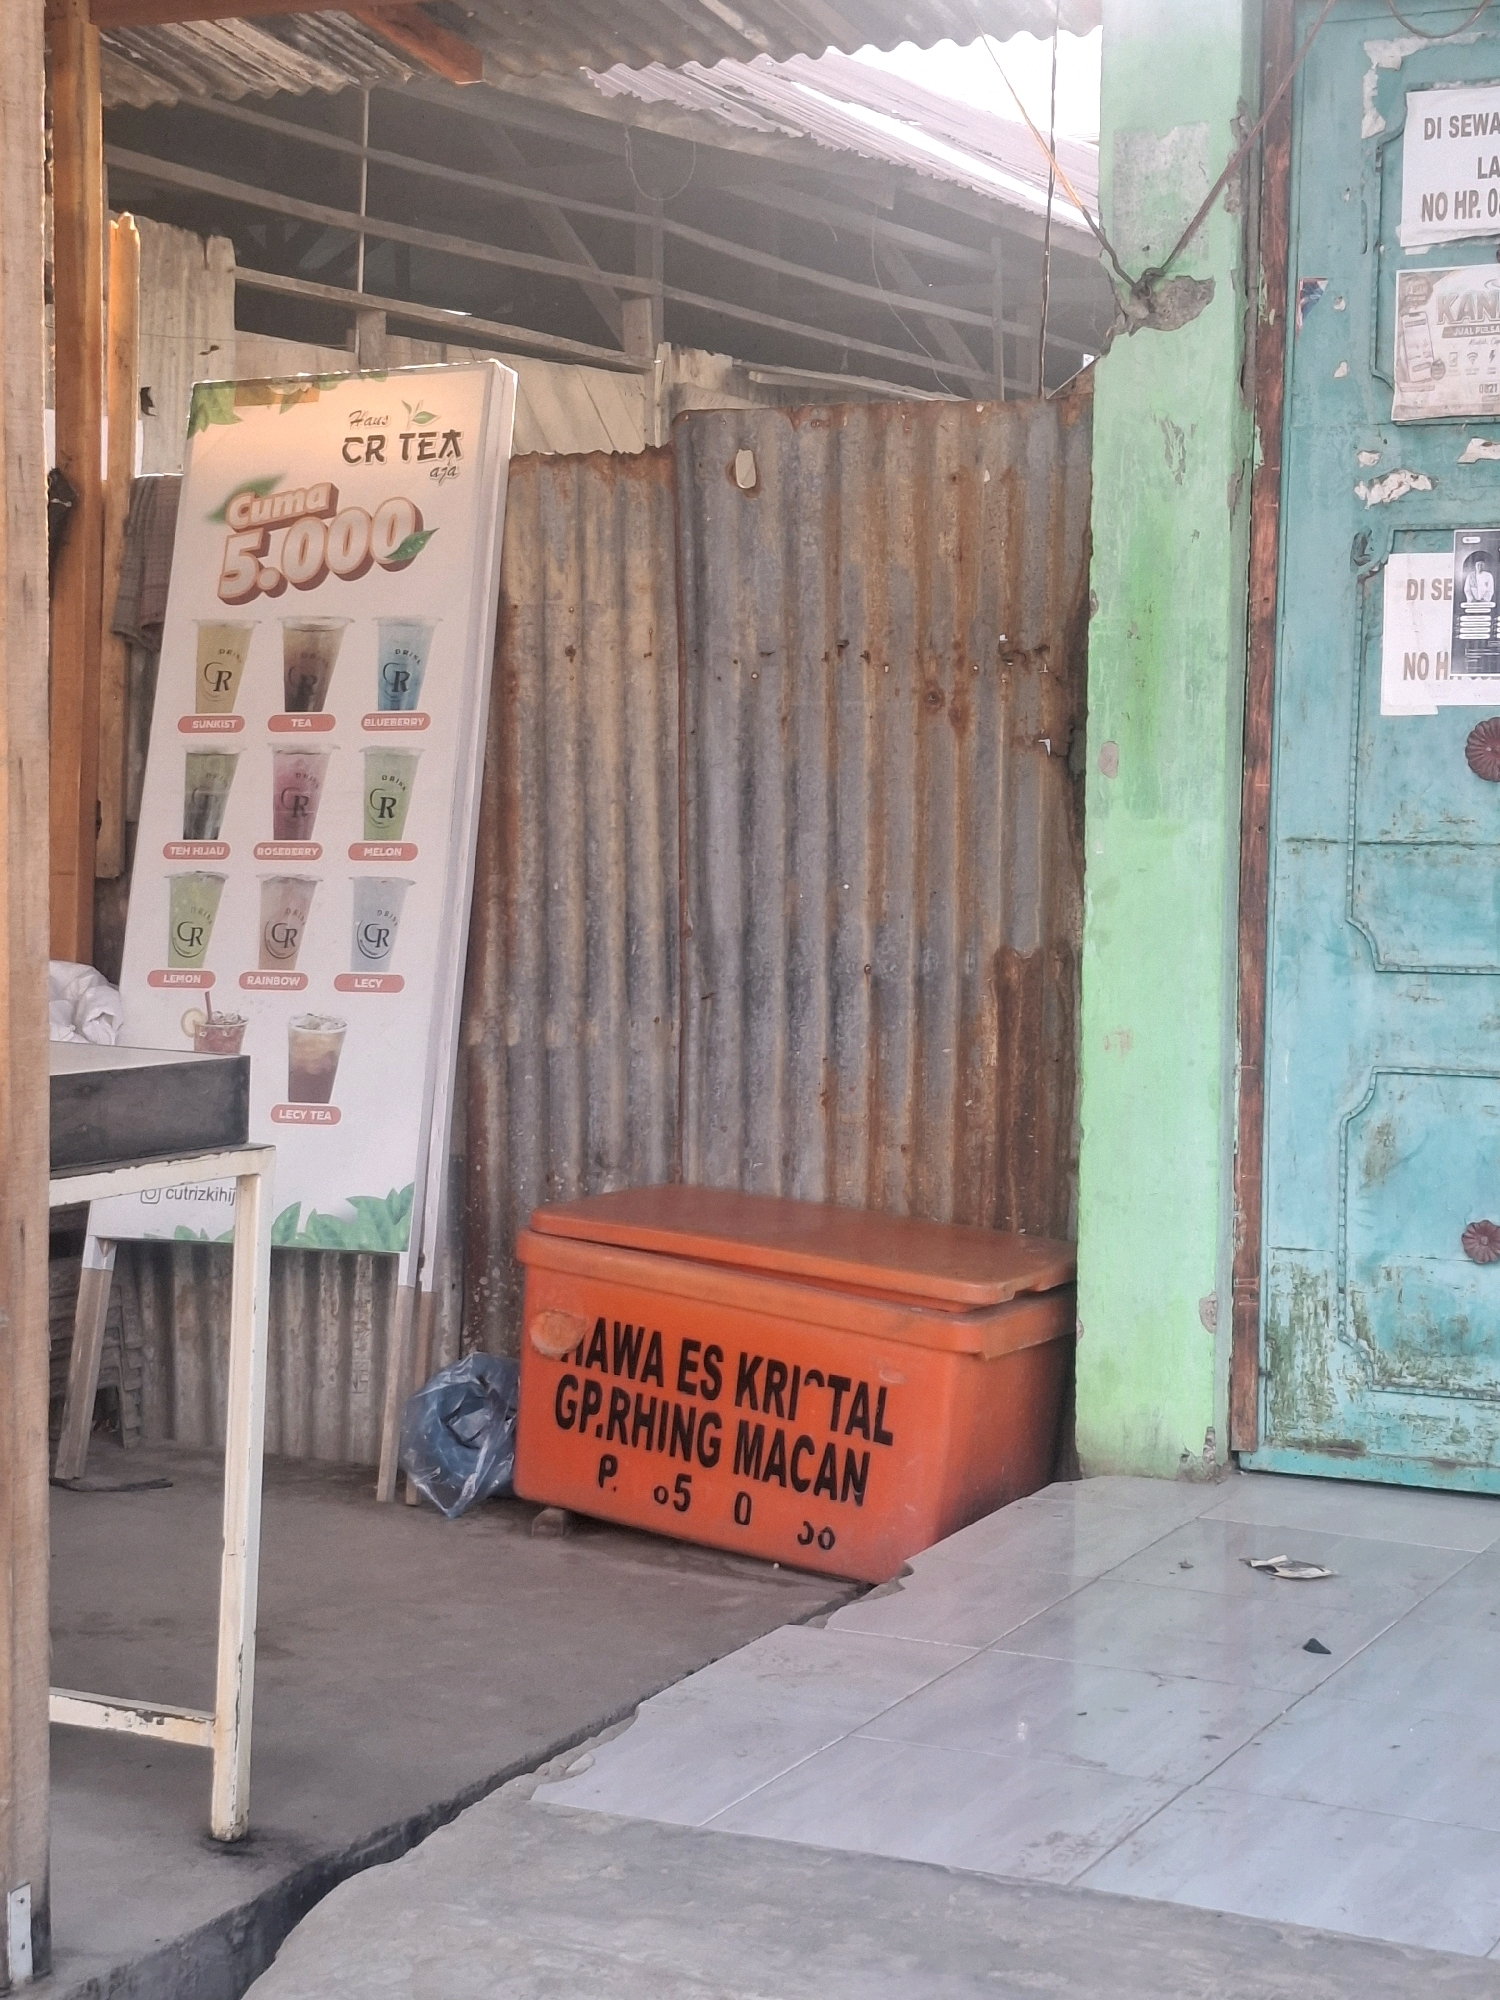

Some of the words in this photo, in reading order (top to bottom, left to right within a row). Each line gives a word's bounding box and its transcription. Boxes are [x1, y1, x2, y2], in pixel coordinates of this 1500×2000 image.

[1424, 117, 1442, 140] DI
[1421, 191, 1448, 222] NO
[1454, 189, 1481, 219] HP.
[1436, 290, 1500, 325] KAN
[341, 434, 386, 464] CR
[399, 429, 462, 461] TEA
[429, 461, 457, 485] aja
[226, 482, 336, 532] Cuma
[217, 497, 421, 603] 5.000
[1406, 578, 1425, 601] DI
[1403, 652, 1430, 681] NO
[191, 719, 239, 729] SUNKIST
[291, 718, 312, 728] TEA
[169, 846, 191, 855] TEH
[193, 846, 225, 856] HIJAU
[363, 847, 403, 857] MELON
[163, 974, 202, 984] LEMON
[247, 975, 301, 986] RAINBOW
[354, 978, 384, 989] LECY
[278, 1109, 308, 1121] LECY
[310, 1110, 333, 1121] TEA
[677, 1337, 724, 1401] ES
[733, 1419, 871, 1507] MACAN
